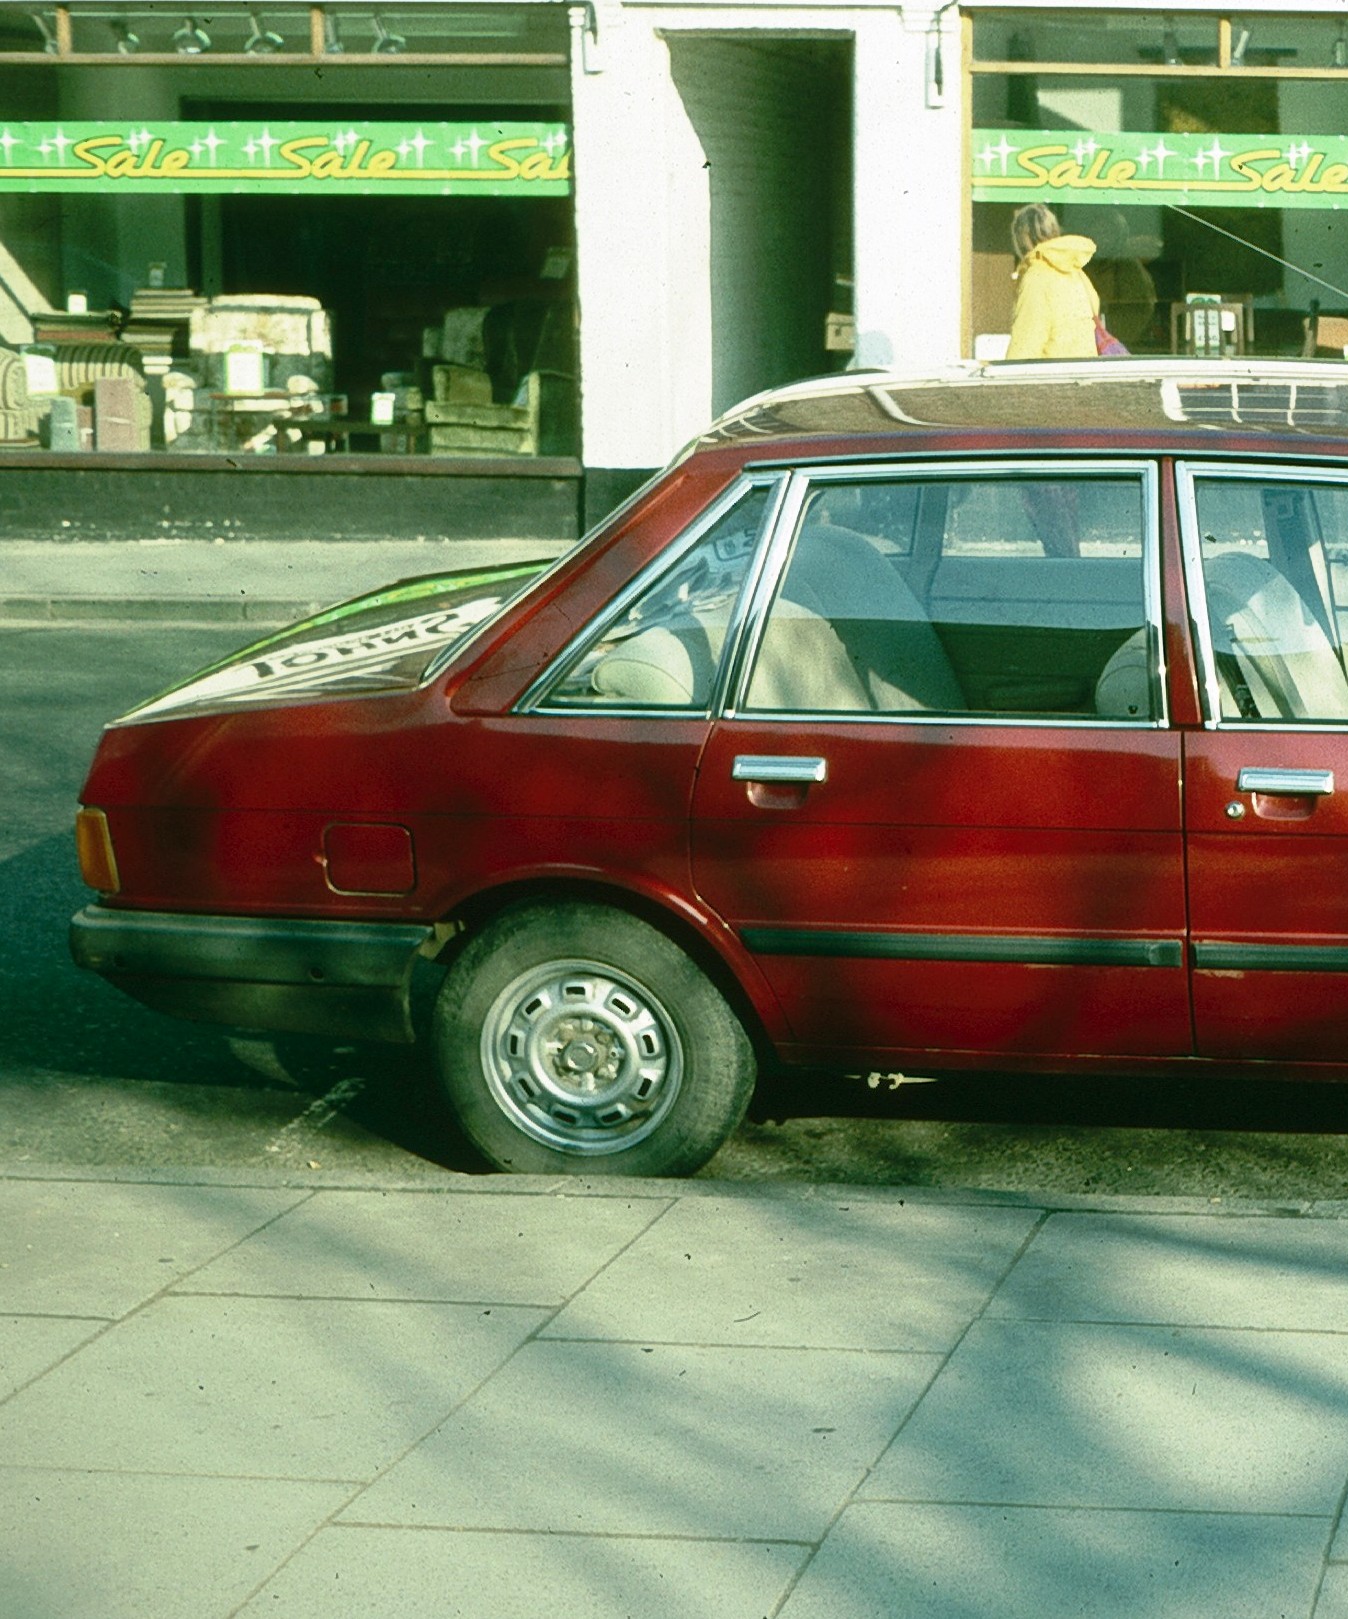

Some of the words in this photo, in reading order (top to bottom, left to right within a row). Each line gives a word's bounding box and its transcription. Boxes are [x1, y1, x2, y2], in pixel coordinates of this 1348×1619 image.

[73, 134, 191, 179] Sale
[279, 136, 398, 181] Sale
[1016, 144, 1138, 189] Sale
